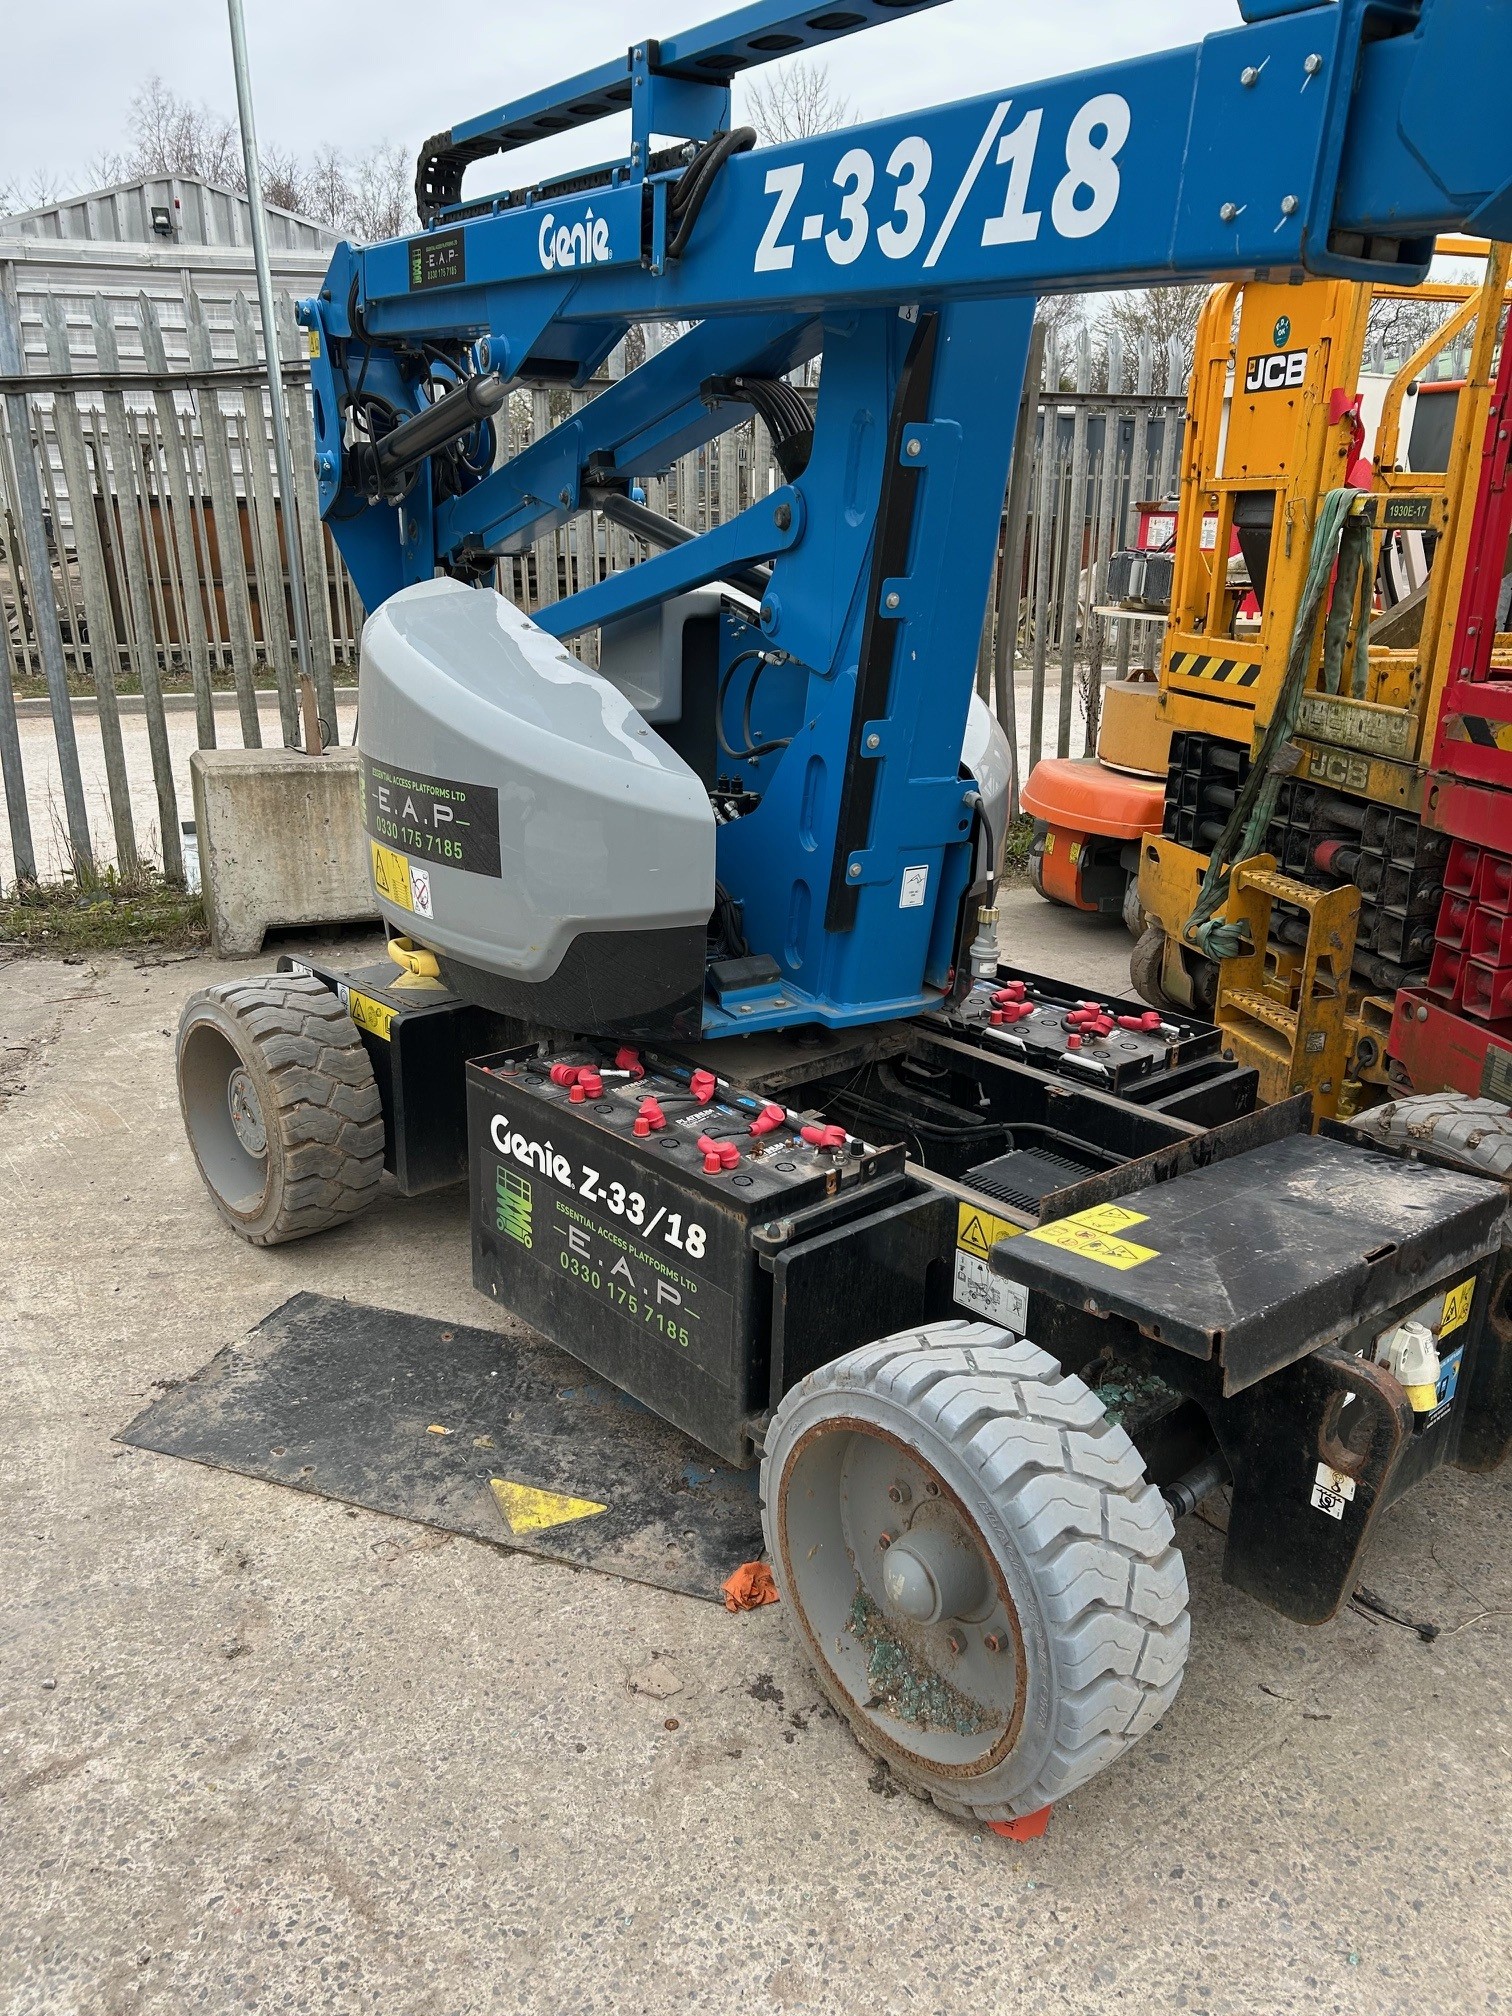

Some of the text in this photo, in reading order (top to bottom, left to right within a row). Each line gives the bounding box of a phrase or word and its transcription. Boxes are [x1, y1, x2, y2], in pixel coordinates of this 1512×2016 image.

[753, 93, 1131, 273] Z-33/18
[538, 206, 610, 271] Genie
[1246, 352, 1308, 391] JCB
[1390, 505, 1428, 517] 1930E-17
[393, 776, 412, 790] ACCESS
[412, 781, 450, 799] PLATFORMS
[451, 790, 466, 802] LTD
[1310, 753, 1369, 789] JCB
[376, 815, 463, 860] 0330 175 7185
[490, 1114, 707, 1259] Genie Z-33/18
[556, 1200, 698, 1294] ESSENTIAL ACCESS PLATFORMS LTD
[560, 1251, 689, 1347] 0330 175 7185
